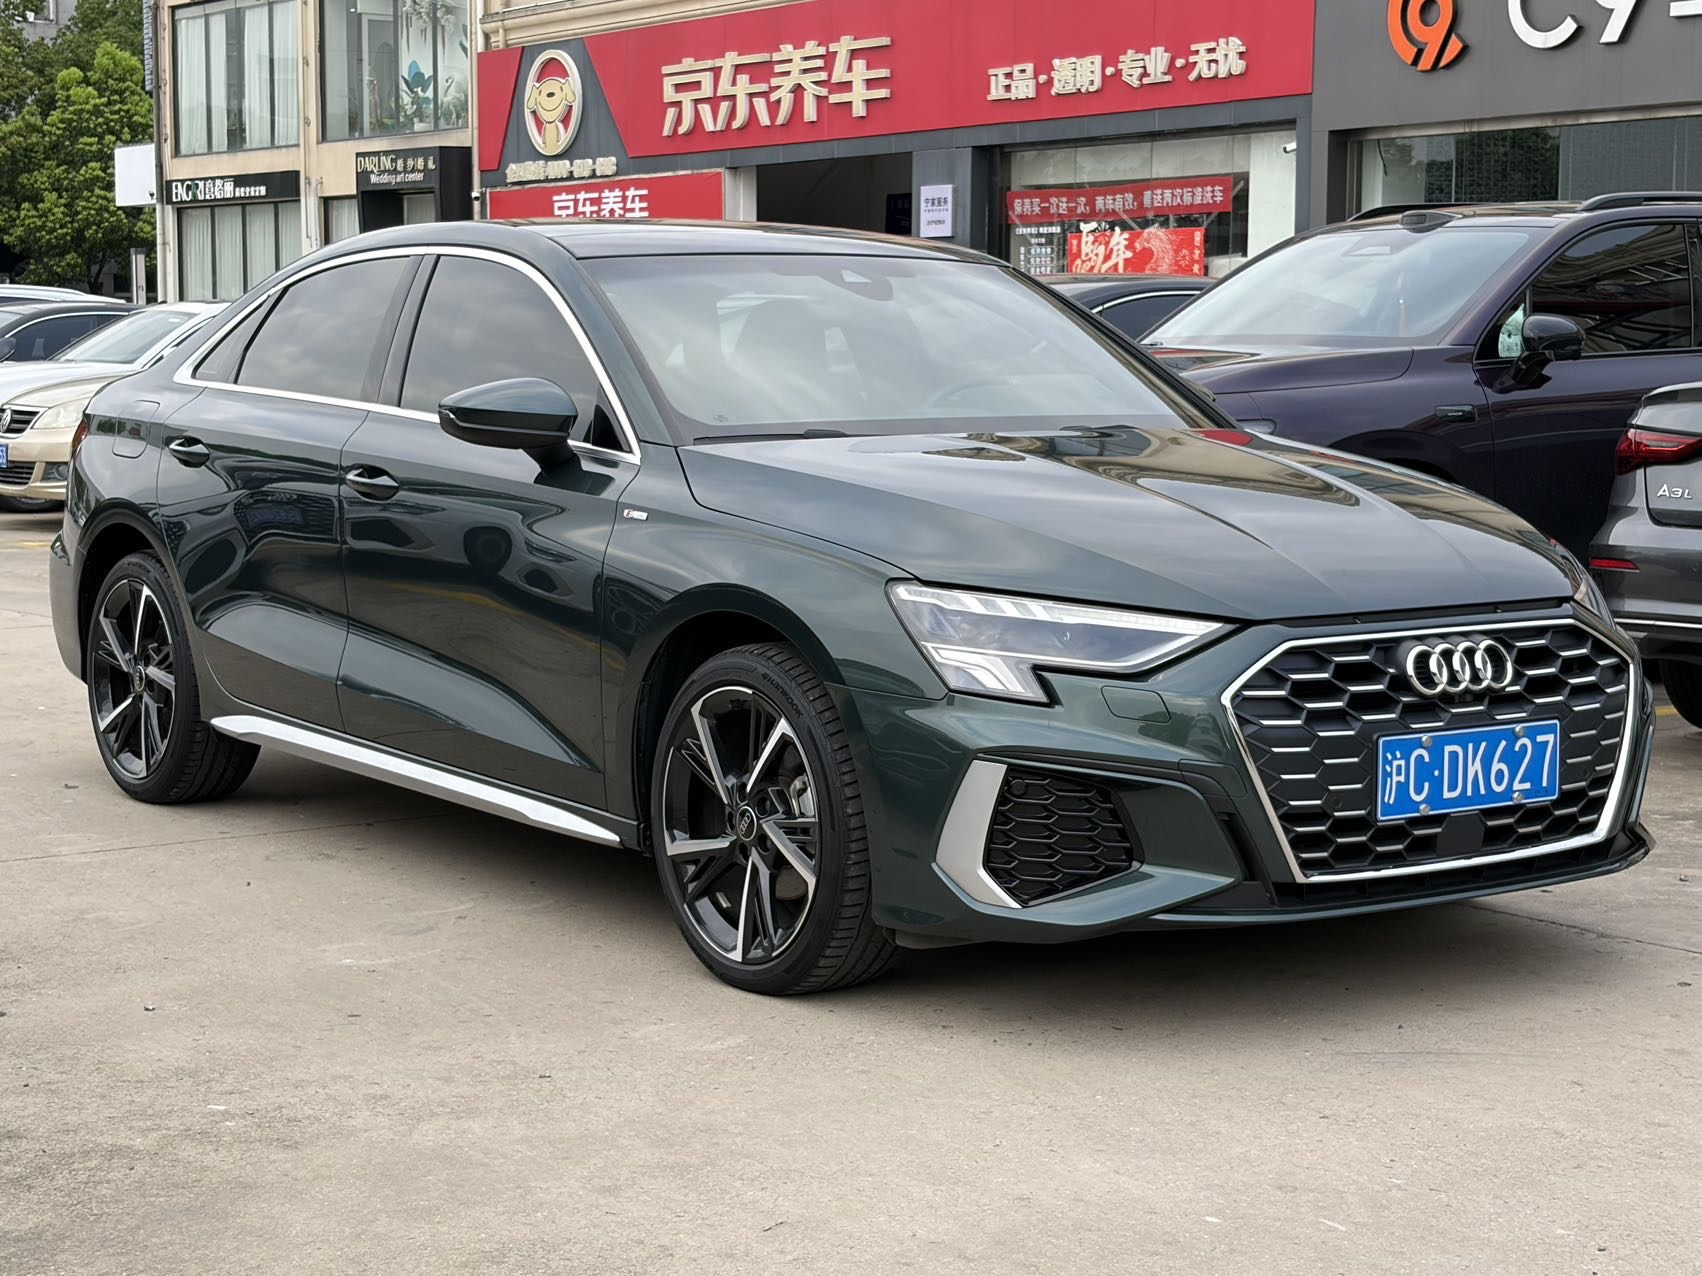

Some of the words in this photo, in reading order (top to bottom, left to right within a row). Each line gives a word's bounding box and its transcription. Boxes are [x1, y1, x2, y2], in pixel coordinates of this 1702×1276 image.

[661, 35, 892, 137] 京东养车
[370, 173, 396, 185] Wedding
[396, 172, 404, 182] art
[552, 187, 649, 218] 京东养车
[1657, 484, 1693, 499] A3L
[1384, 733, 1556, 805] 沪C·DK627
